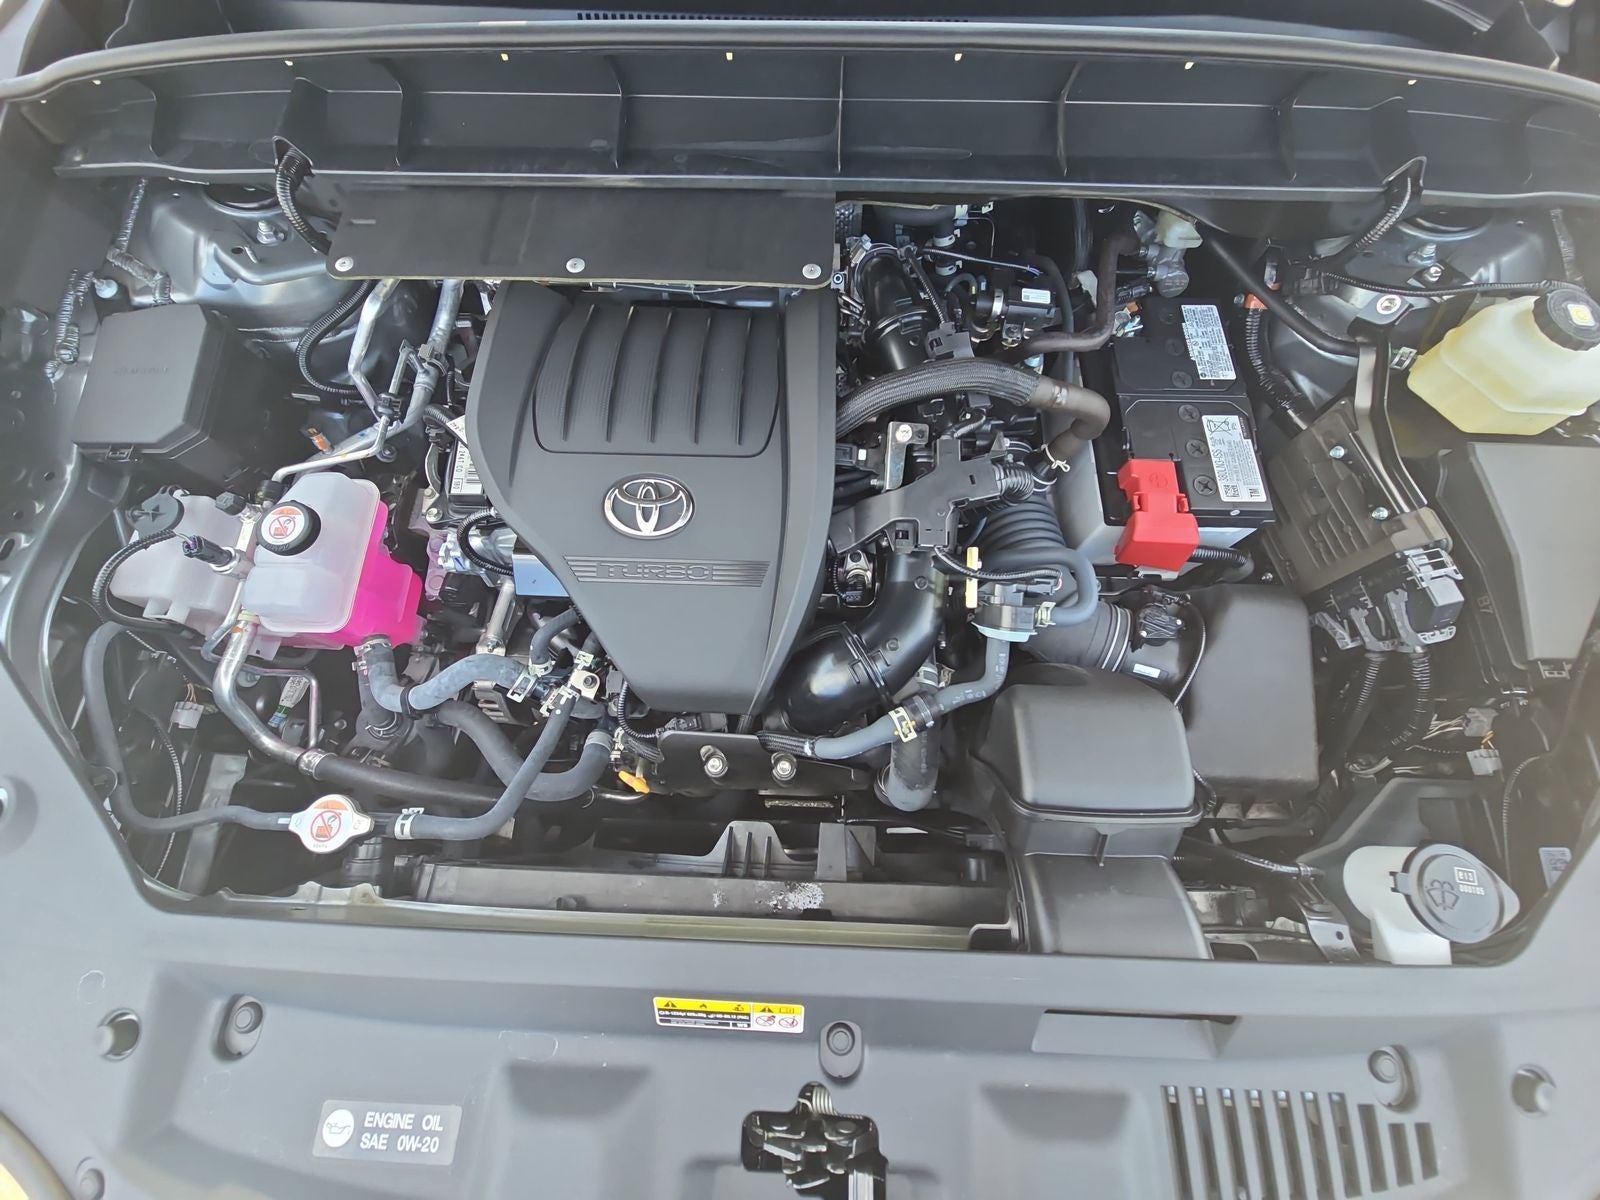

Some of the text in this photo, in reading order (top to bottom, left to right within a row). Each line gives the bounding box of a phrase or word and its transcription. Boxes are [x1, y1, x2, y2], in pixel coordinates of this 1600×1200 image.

[600, 562, 710, 580] TURBO
[363, 1111, 444, 1132] ENGINE OIL
[360, 1132, 440, 1153] SAE 0W-20
